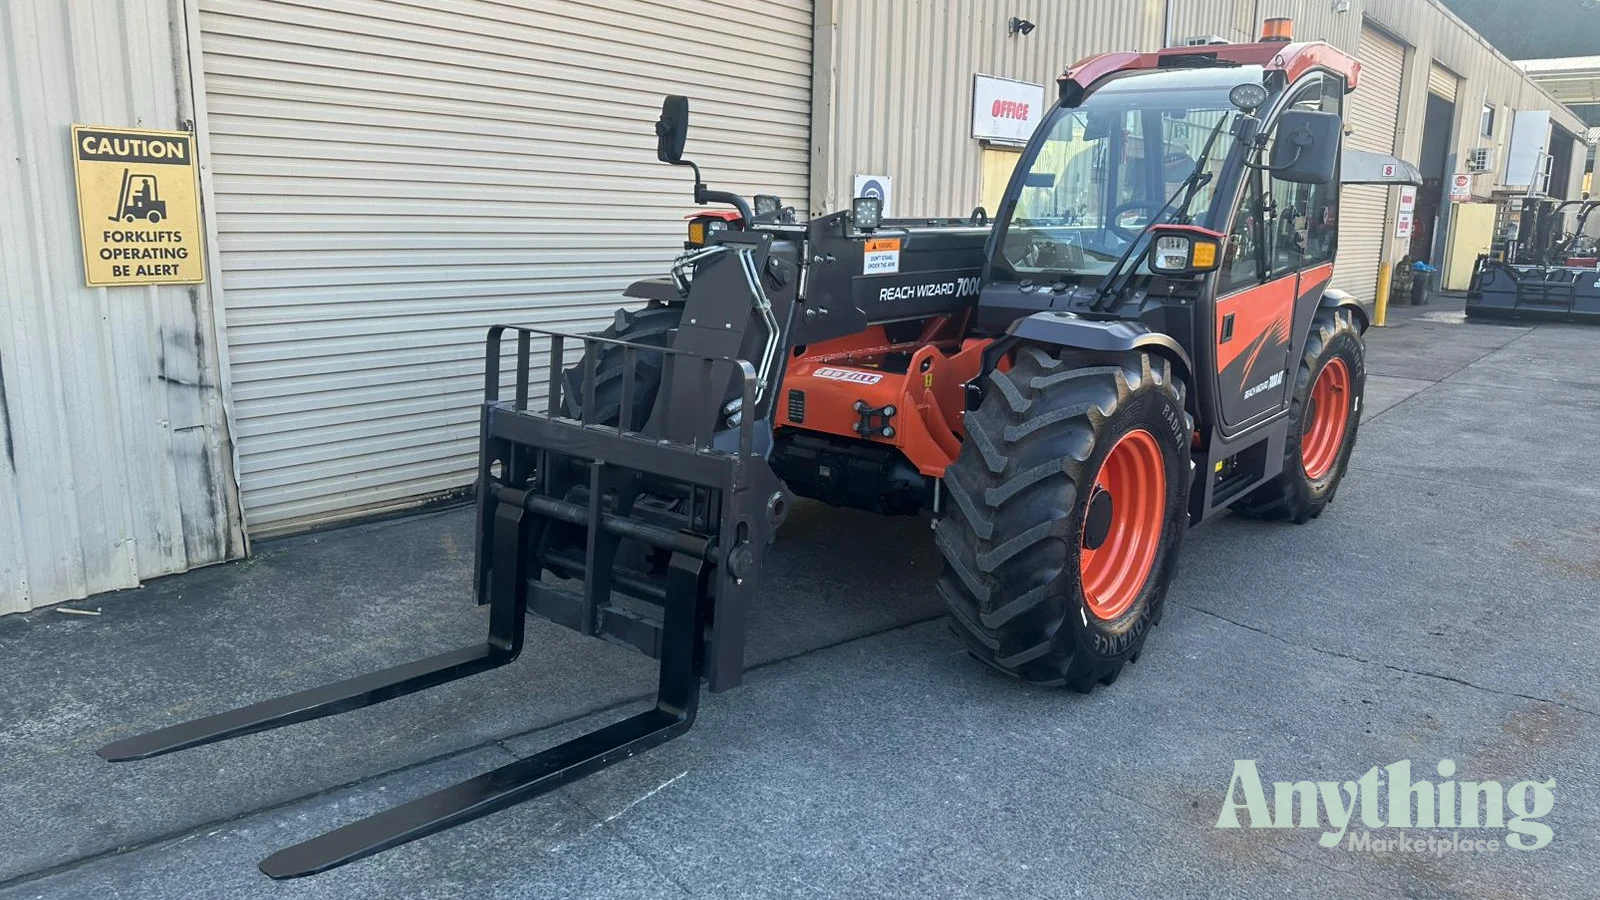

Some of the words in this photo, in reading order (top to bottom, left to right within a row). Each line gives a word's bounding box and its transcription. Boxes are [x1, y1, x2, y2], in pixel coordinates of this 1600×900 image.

[991, 99, 1029, 121] OFFICE
[82, 136, 184, 159] CAUTION
[1385, 166, 1393, 176] 8
[103, 230, 182, 243] FORKLIFTS
[99, 247, 188, 260] OPERATING
[112, 265, 131, 277] BE
[135, 264, 179, 277] ALERT
[879, 286, 916, 301] REACH
[916, 282, 954, 298] WIZARD
